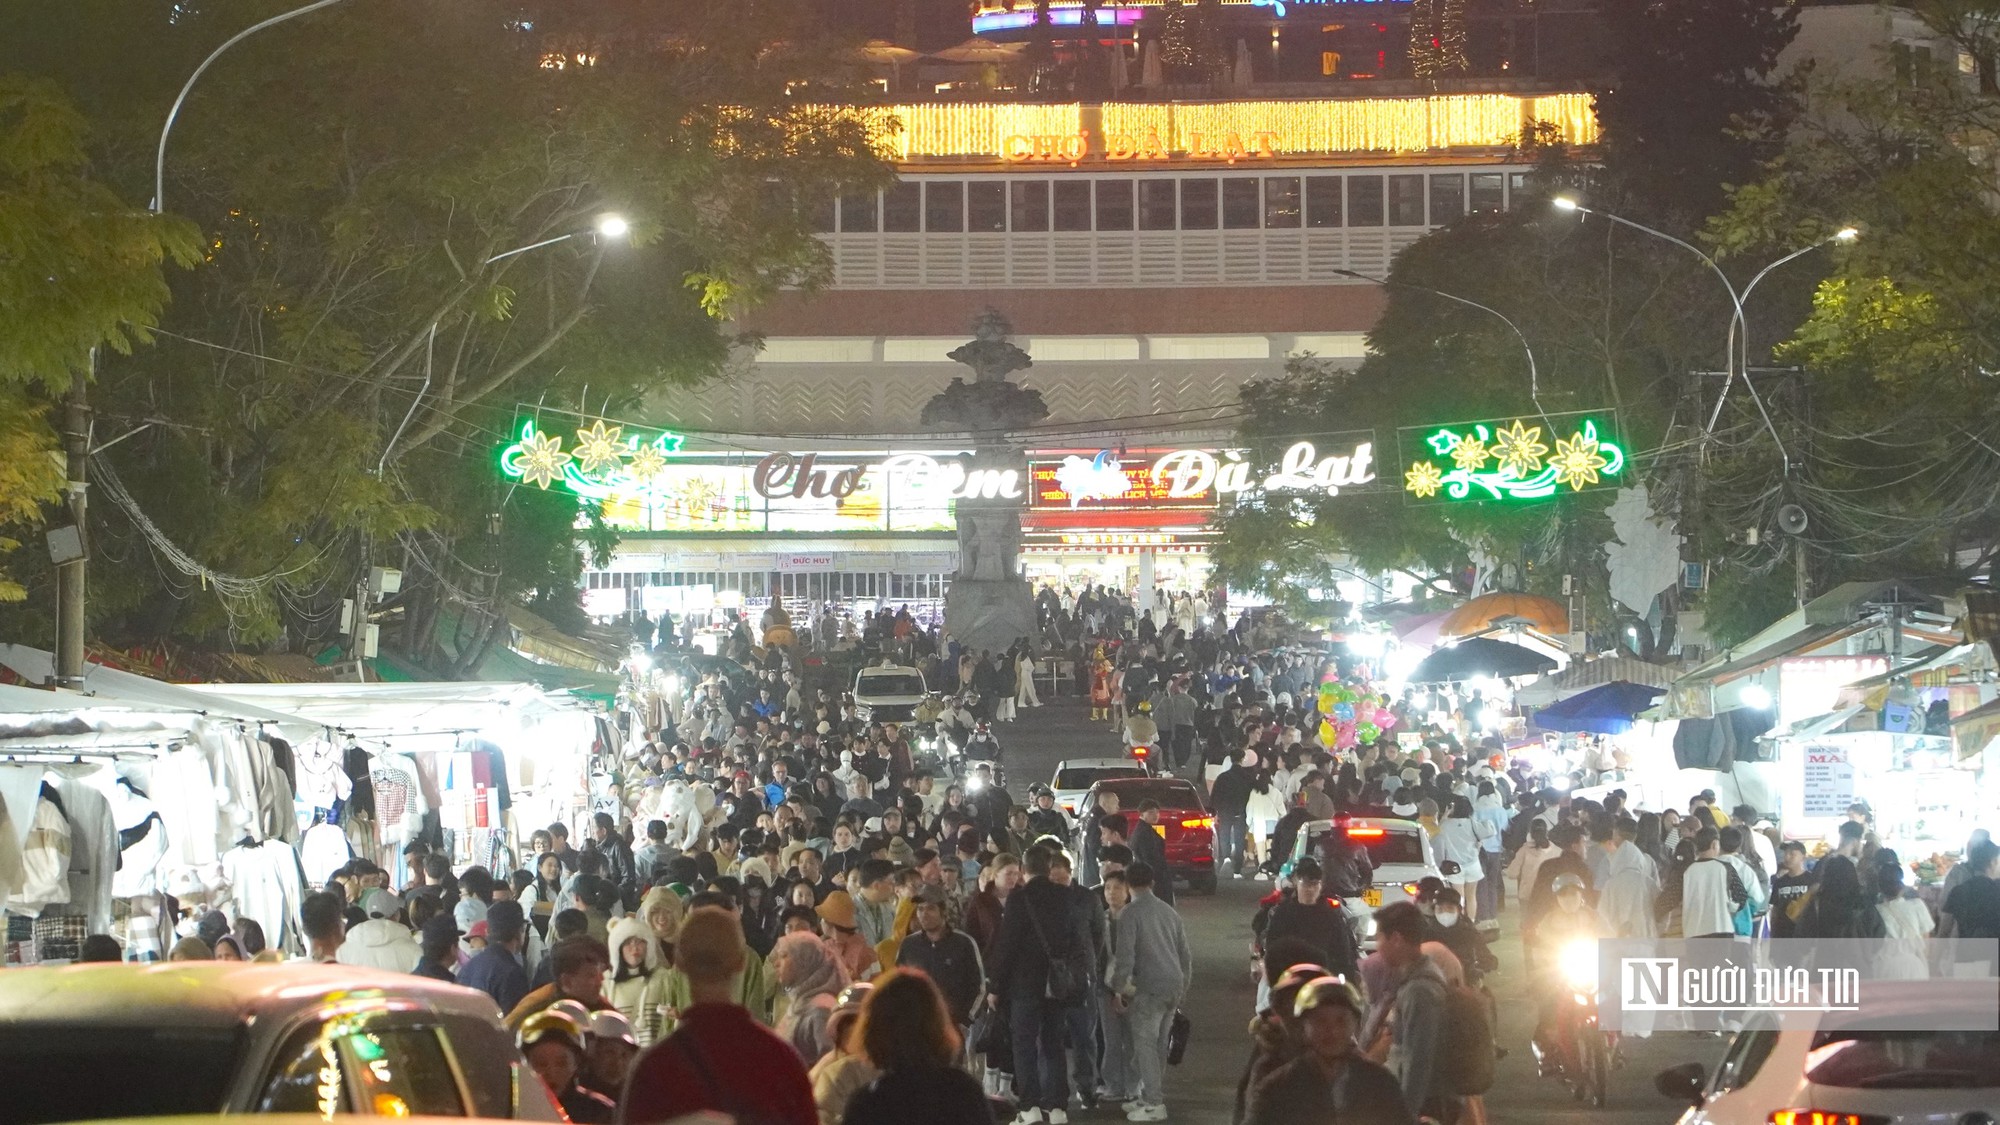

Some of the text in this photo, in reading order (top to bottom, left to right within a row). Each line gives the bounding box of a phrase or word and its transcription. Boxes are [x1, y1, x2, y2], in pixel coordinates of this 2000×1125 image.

[1003, 127, 1278, 167] CHỢ ĐÀ LẠT
[753, 451, 867, 508] Chợ
[1152, 449, 1255, 499] Đà
[1264, 441, 1376, 497] Lạt
